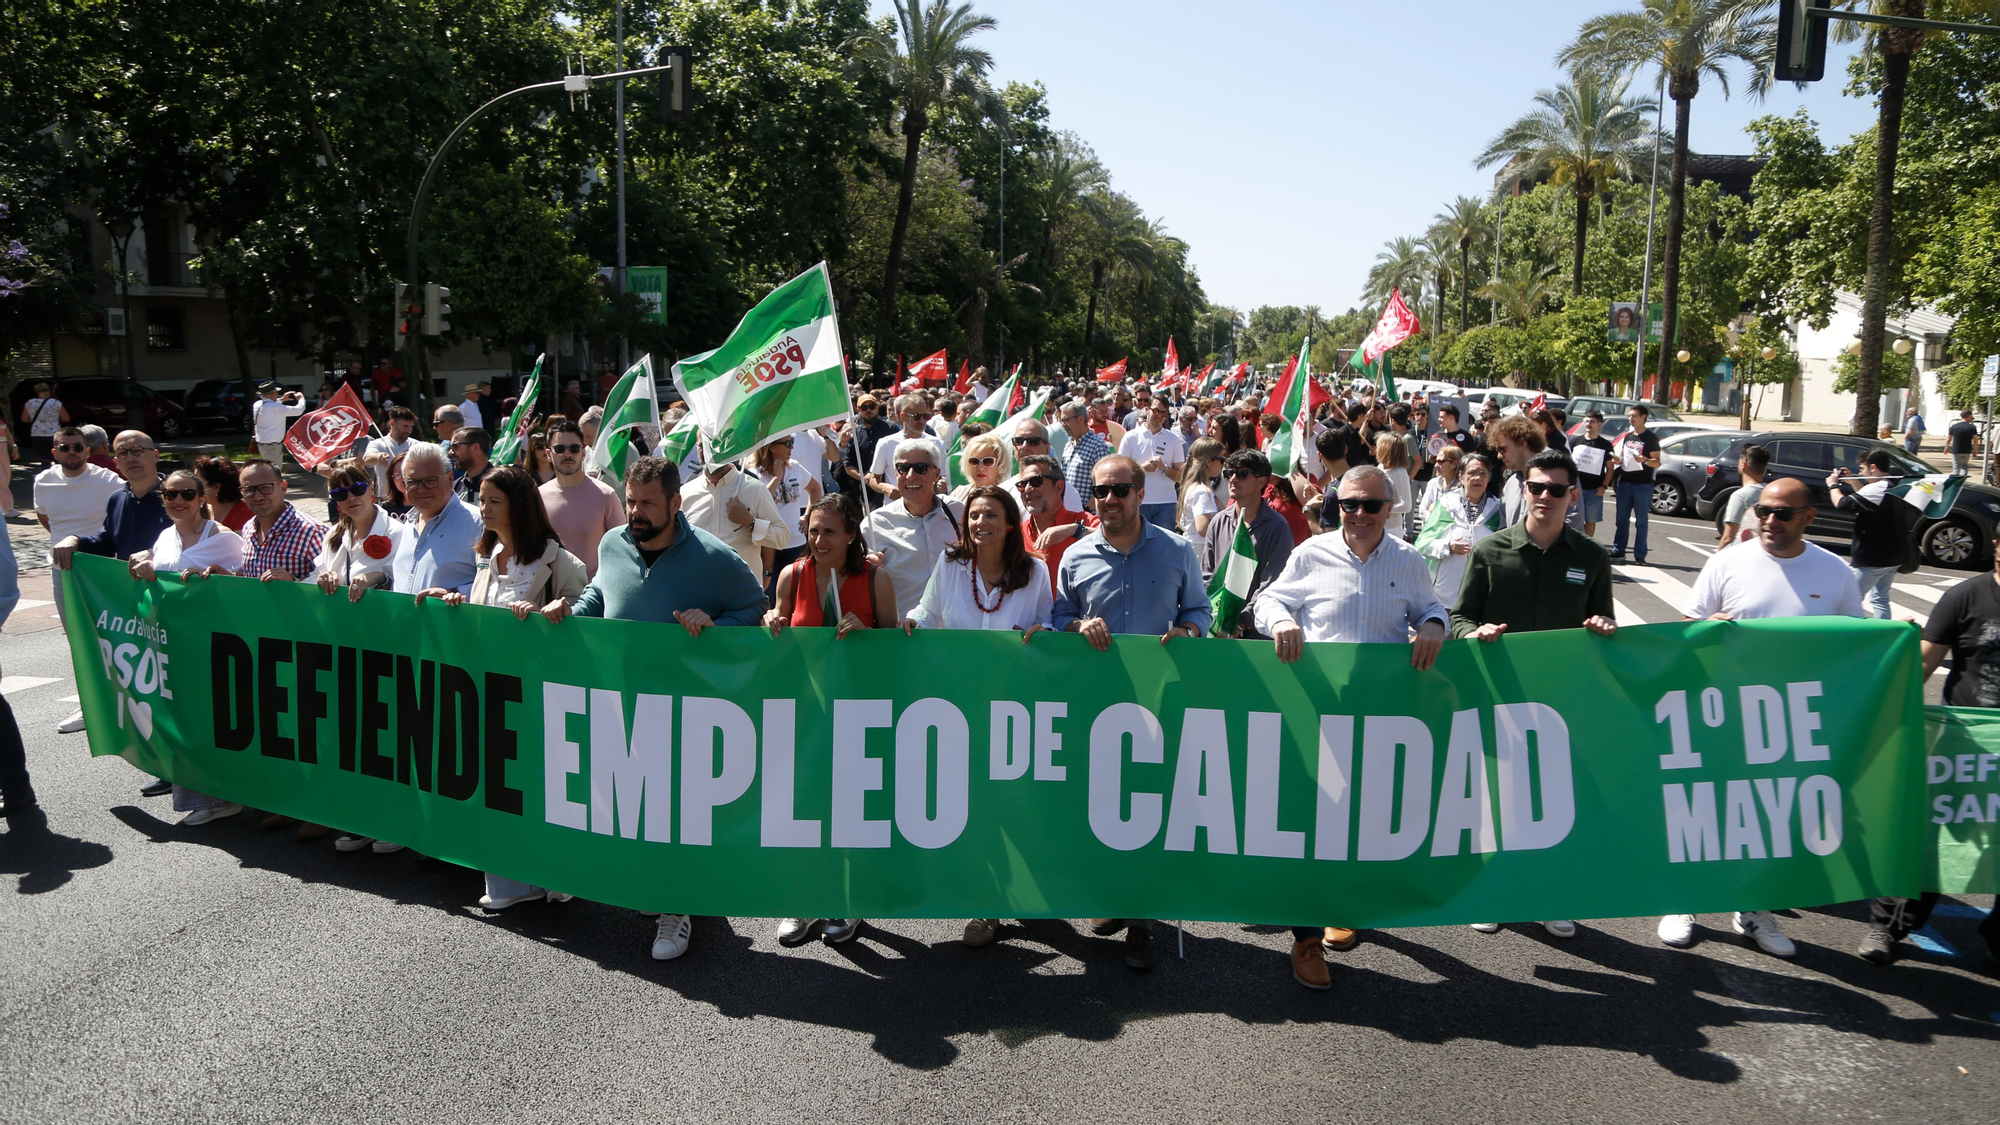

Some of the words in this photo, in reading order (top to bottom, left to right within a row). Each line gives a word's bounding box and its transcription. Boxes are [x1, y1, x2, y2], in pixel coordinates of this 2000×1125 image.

[632, 274, 662, 292] VOTA
[96, 609, 168, 645] Andalucía
[97, 636, 173, 701] PSOE
[211, 631, 524, 817] DEFIENDE
[542, 681, 970, 849] EMPLEO
[989, 700, 1068, 782] DE
[1088, 701, 1576, 861] CALIDAD
[1738, 680, 1831, 765] DE
[1926, 753, 2000, 785] DEF
[1662, 774, 1844, 864] MAYO
[1931, 793, 2000, 825] SAN
